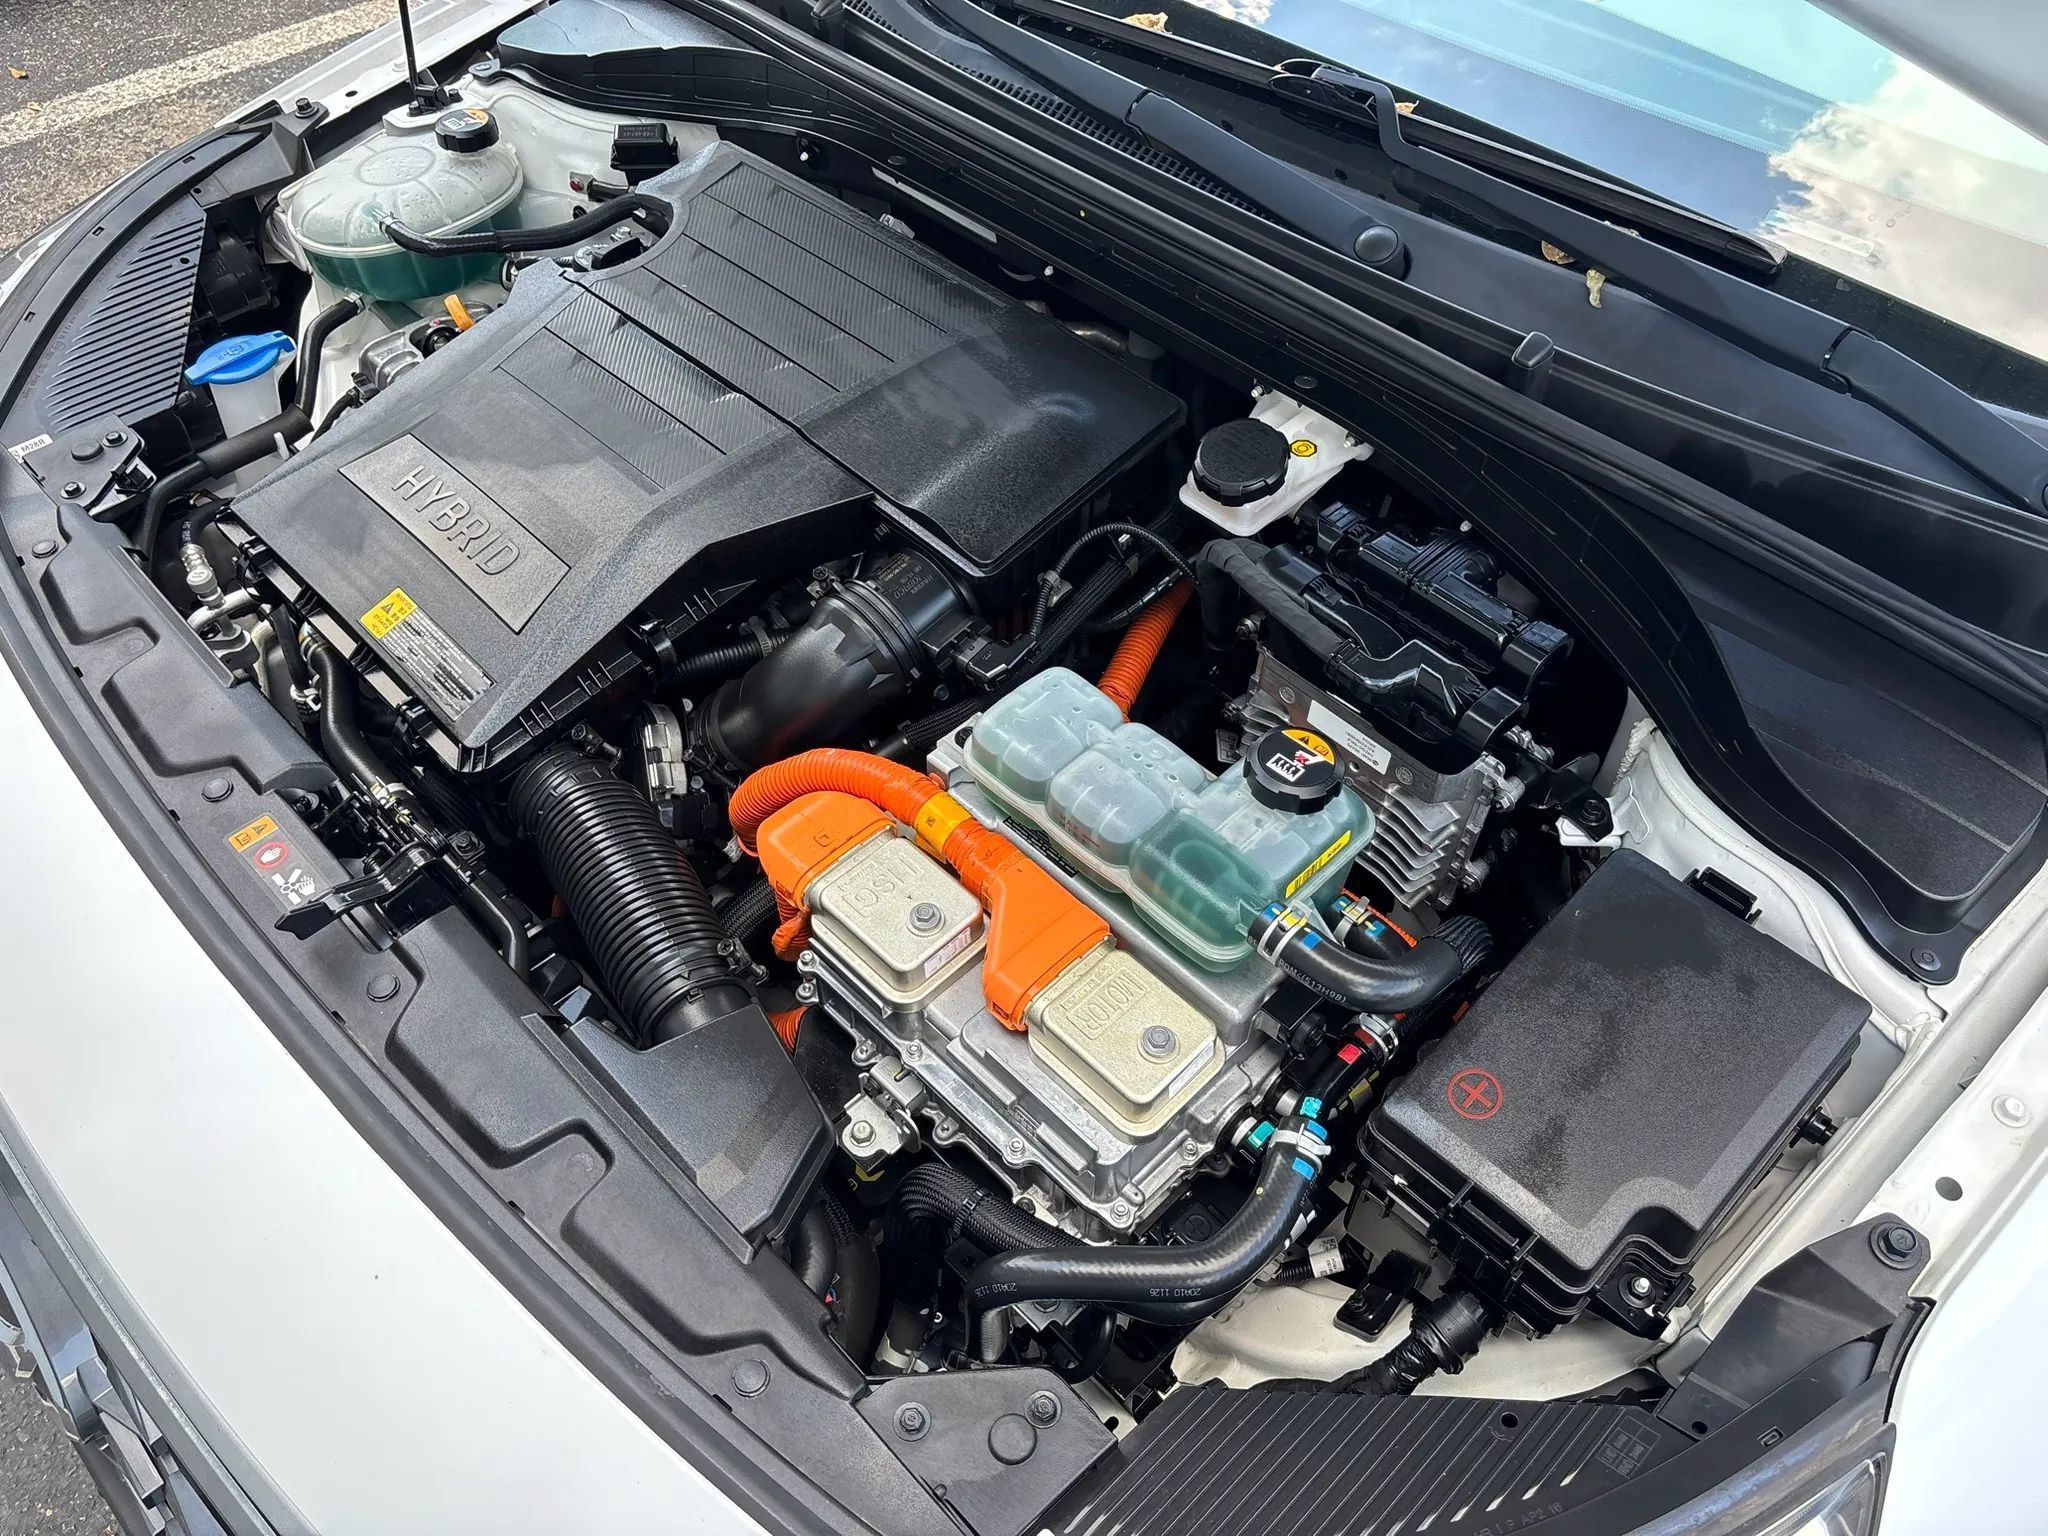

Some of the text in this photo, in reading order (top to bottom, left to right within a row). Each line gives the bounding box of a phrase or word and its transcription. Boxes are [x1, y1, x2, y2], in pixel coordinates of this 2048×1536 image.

[391, 465, 520, 575] HYBRID
[1073, 971, 1144, 1031] MOTOR
[1149, 1288, 1170, 1297] 1126
